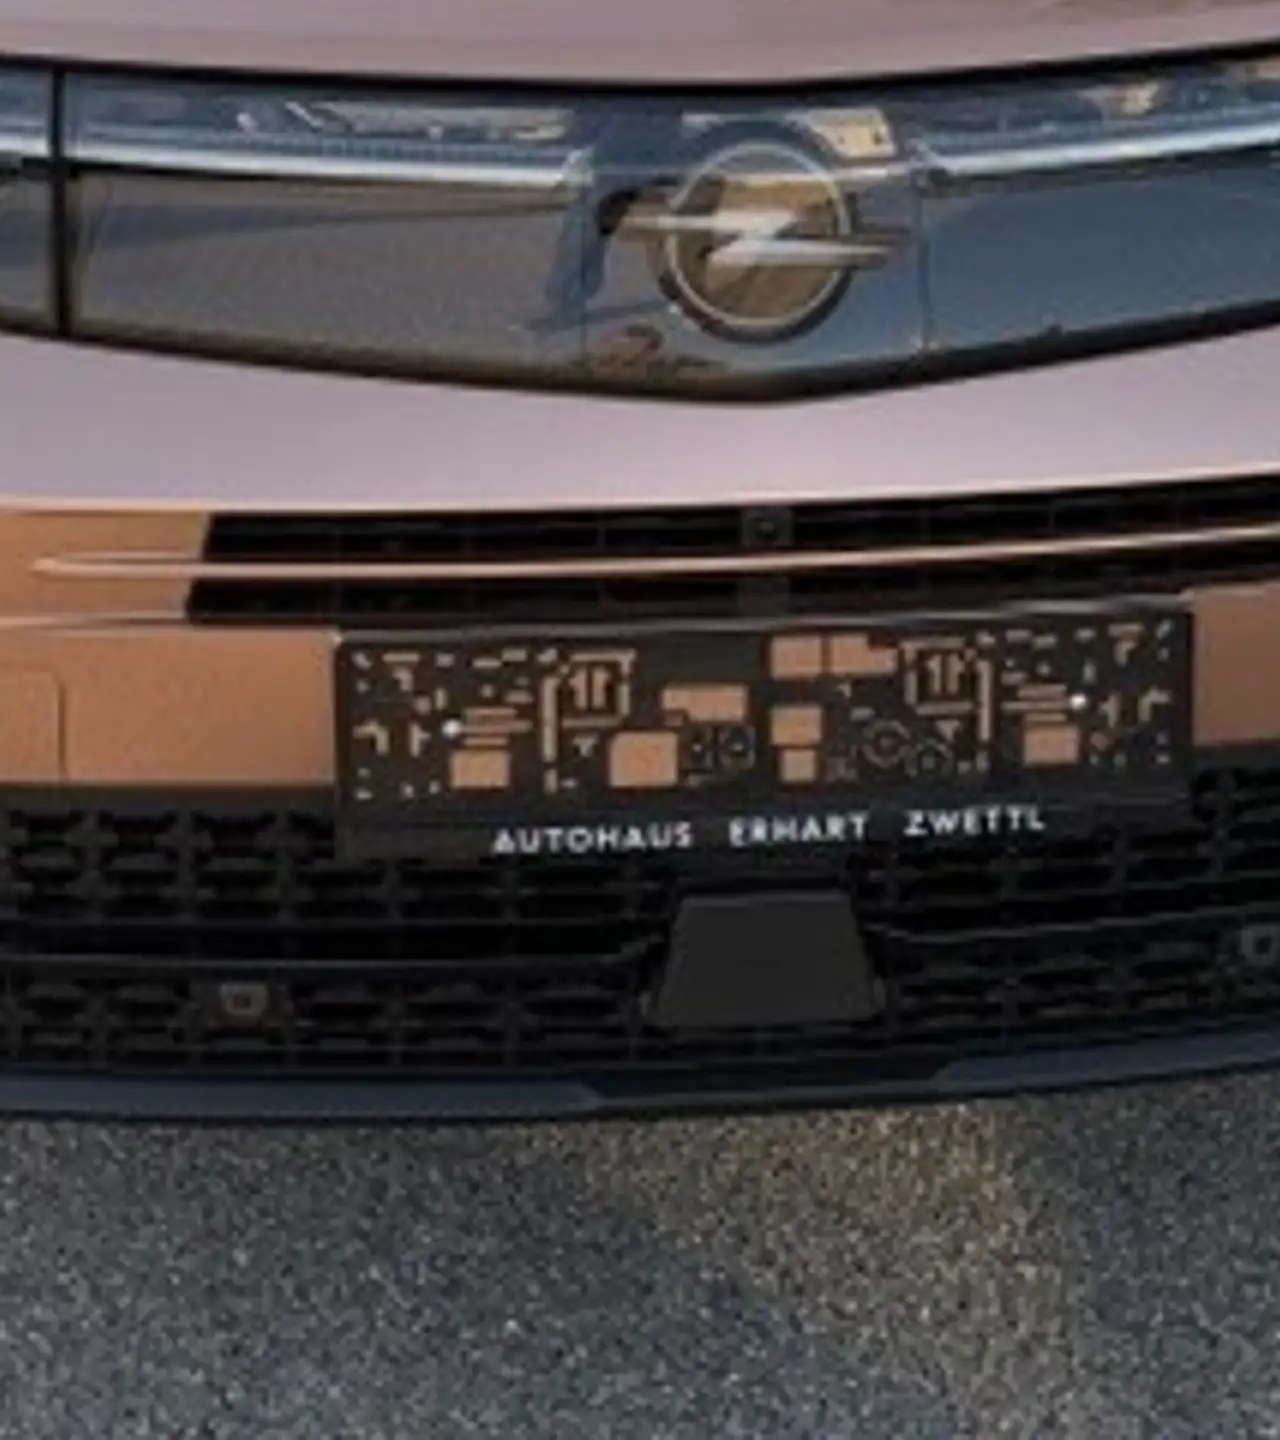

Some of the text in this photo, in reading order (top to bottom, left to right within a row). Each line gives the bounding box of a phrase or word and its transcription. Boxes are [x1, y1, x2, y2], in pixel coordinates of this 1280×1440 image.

[491, 804, 1046, 855] AUTOHAUS ERHART ZWETTL
